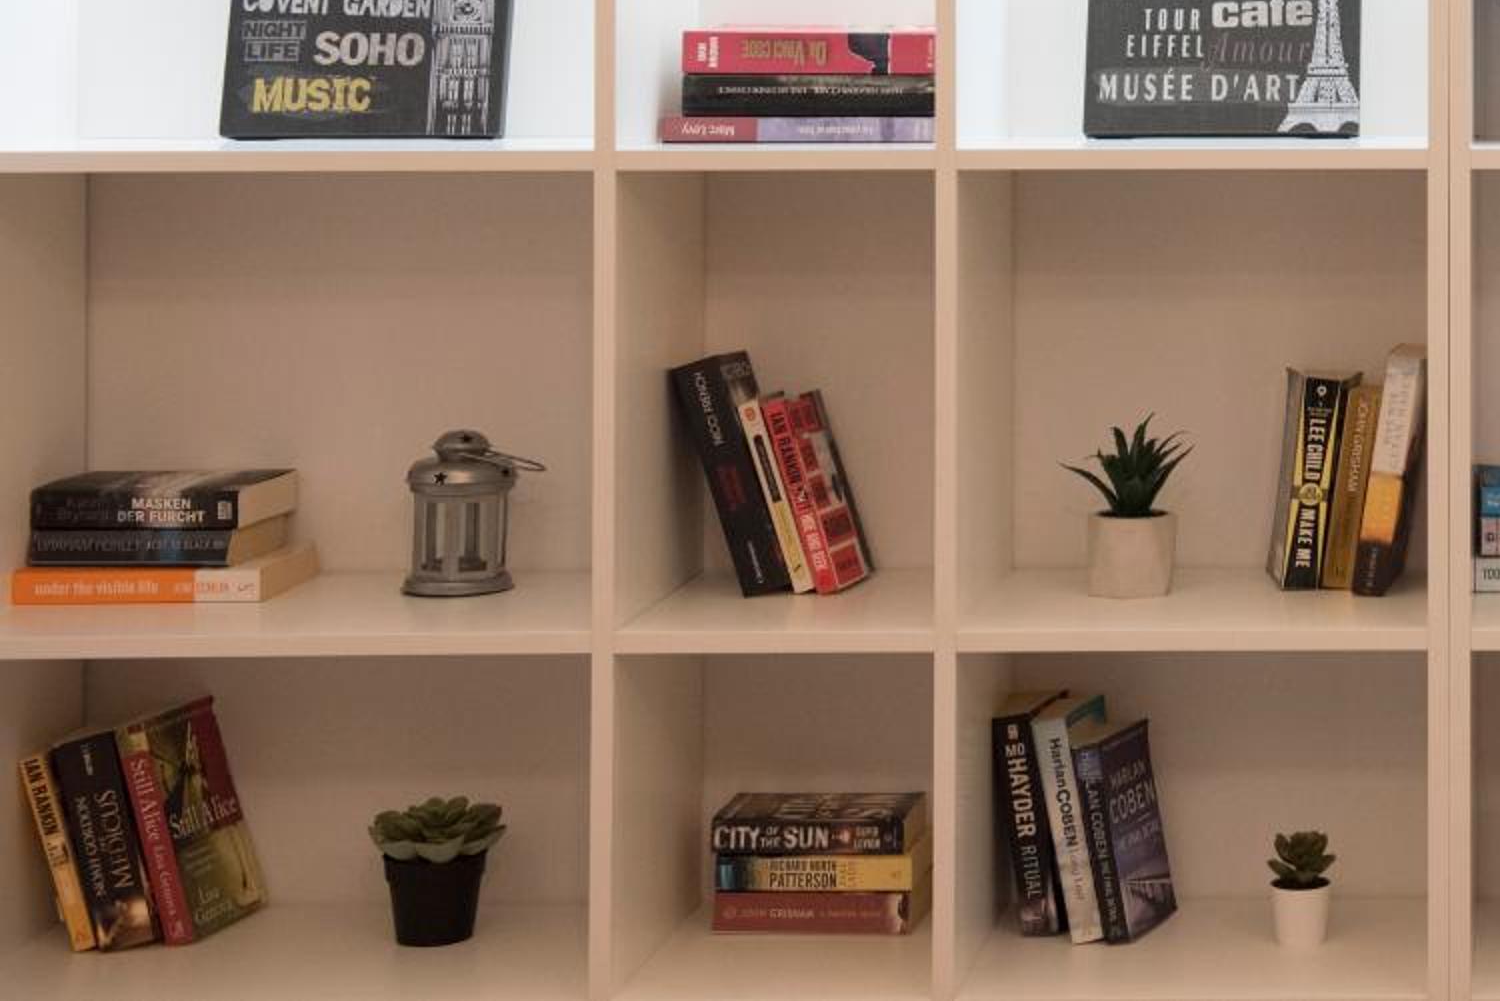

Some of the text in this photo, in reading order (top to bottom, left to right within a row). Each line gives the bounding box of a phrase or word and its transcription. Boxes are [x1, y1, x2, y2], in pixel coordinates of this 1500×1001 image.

[245, 21, 308, 39] NIGHT
[1145, 8, 1201, 31] TOUR
[246, 42, 300, 61] LIFE
[313, 31, 425, 66] SOHO
[1126, 35, 1204, 58] EIFFEL
[1203, 32, 1310, 72] Amour
[253, 76, 371, 113] MUSIC
[1099, 67, 1300, 101] MUSÉE D'ART
[771, 411, 801, 484] IAN RANKIN
[1304, 418, 1327, 481] LEE CHILD
[117, 510, 206, 522] DER FURCHT
[131, 497, 192, 510] MASKEN
[1295, 508, 1316, 568] MAKE ME
[34, 582, 68, 595] under
[1483, 566, 1500, 580] TOO
[24, 757, 45, 784] IAN
[131, 758, 160, 840] Still Alice
[1007, 755, 1037, 839] HAYDER
[1048, 737, 1079, 848] Harlan COBEN
[1108, 779, 1155, 824] COBEN
[31, 784, 60, 837] RANKIN
[200, 793, 241, 829] Alice
[96, 789, 135, 888] MEDICUS
[714, 825, 830, 849] CITY OF THE SUN
[1090, 807, 1108, 859] COBEN
[769, 860, 837, 872] RICHARD NORTH
[769, 872, 837, 888] PATTERSON
[1020, 845, 1042, 898] RITUAL
